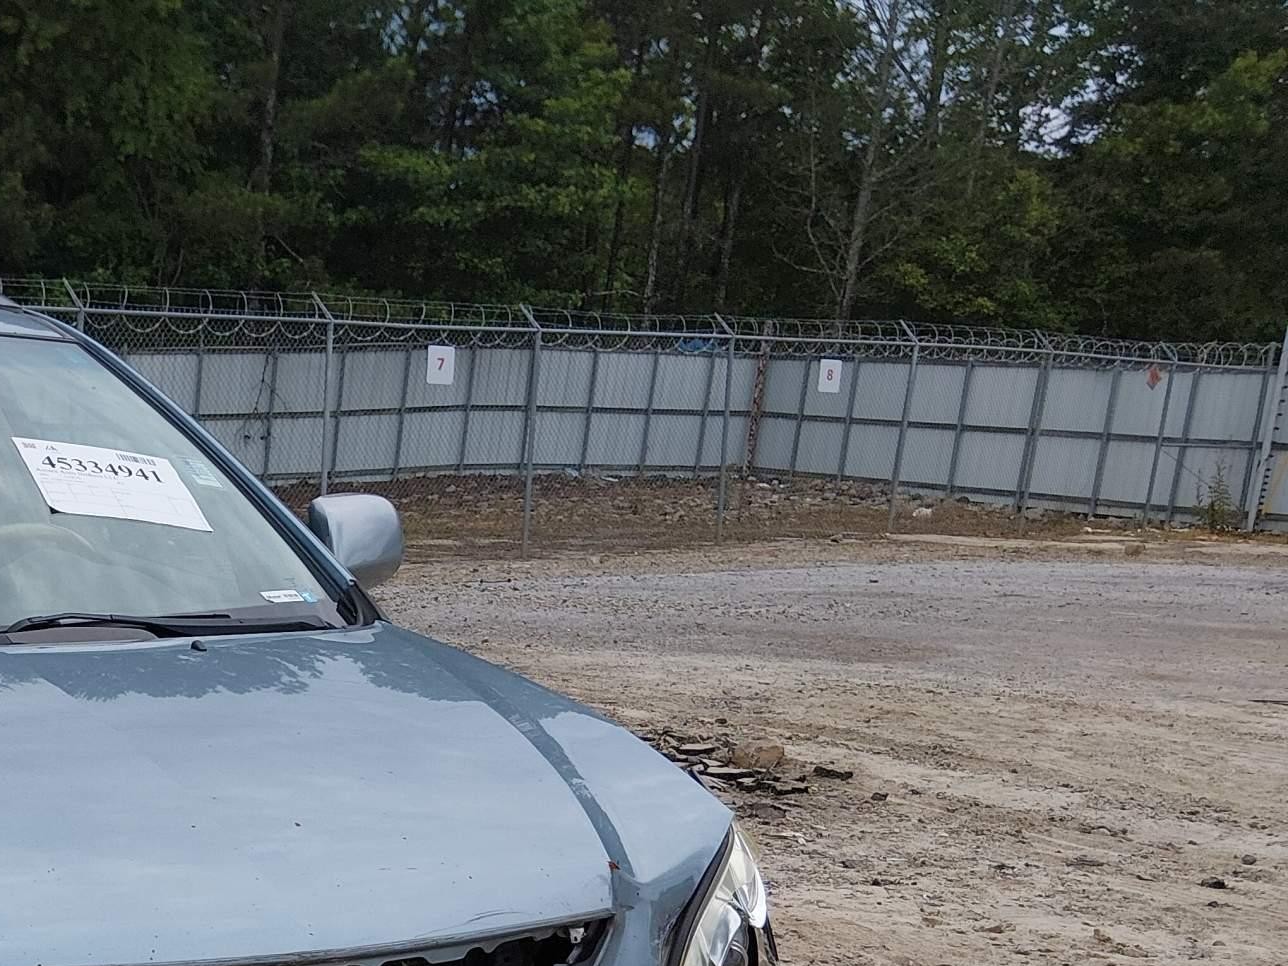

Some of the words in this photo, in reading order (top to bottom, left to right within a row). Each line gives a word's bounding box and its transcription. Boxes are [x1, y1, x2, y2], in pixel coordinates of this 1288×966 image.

[437, 357, 445, 370] 7
[826, 368, 834, 381] 8
[41, 455, 165, 484] 45334941
